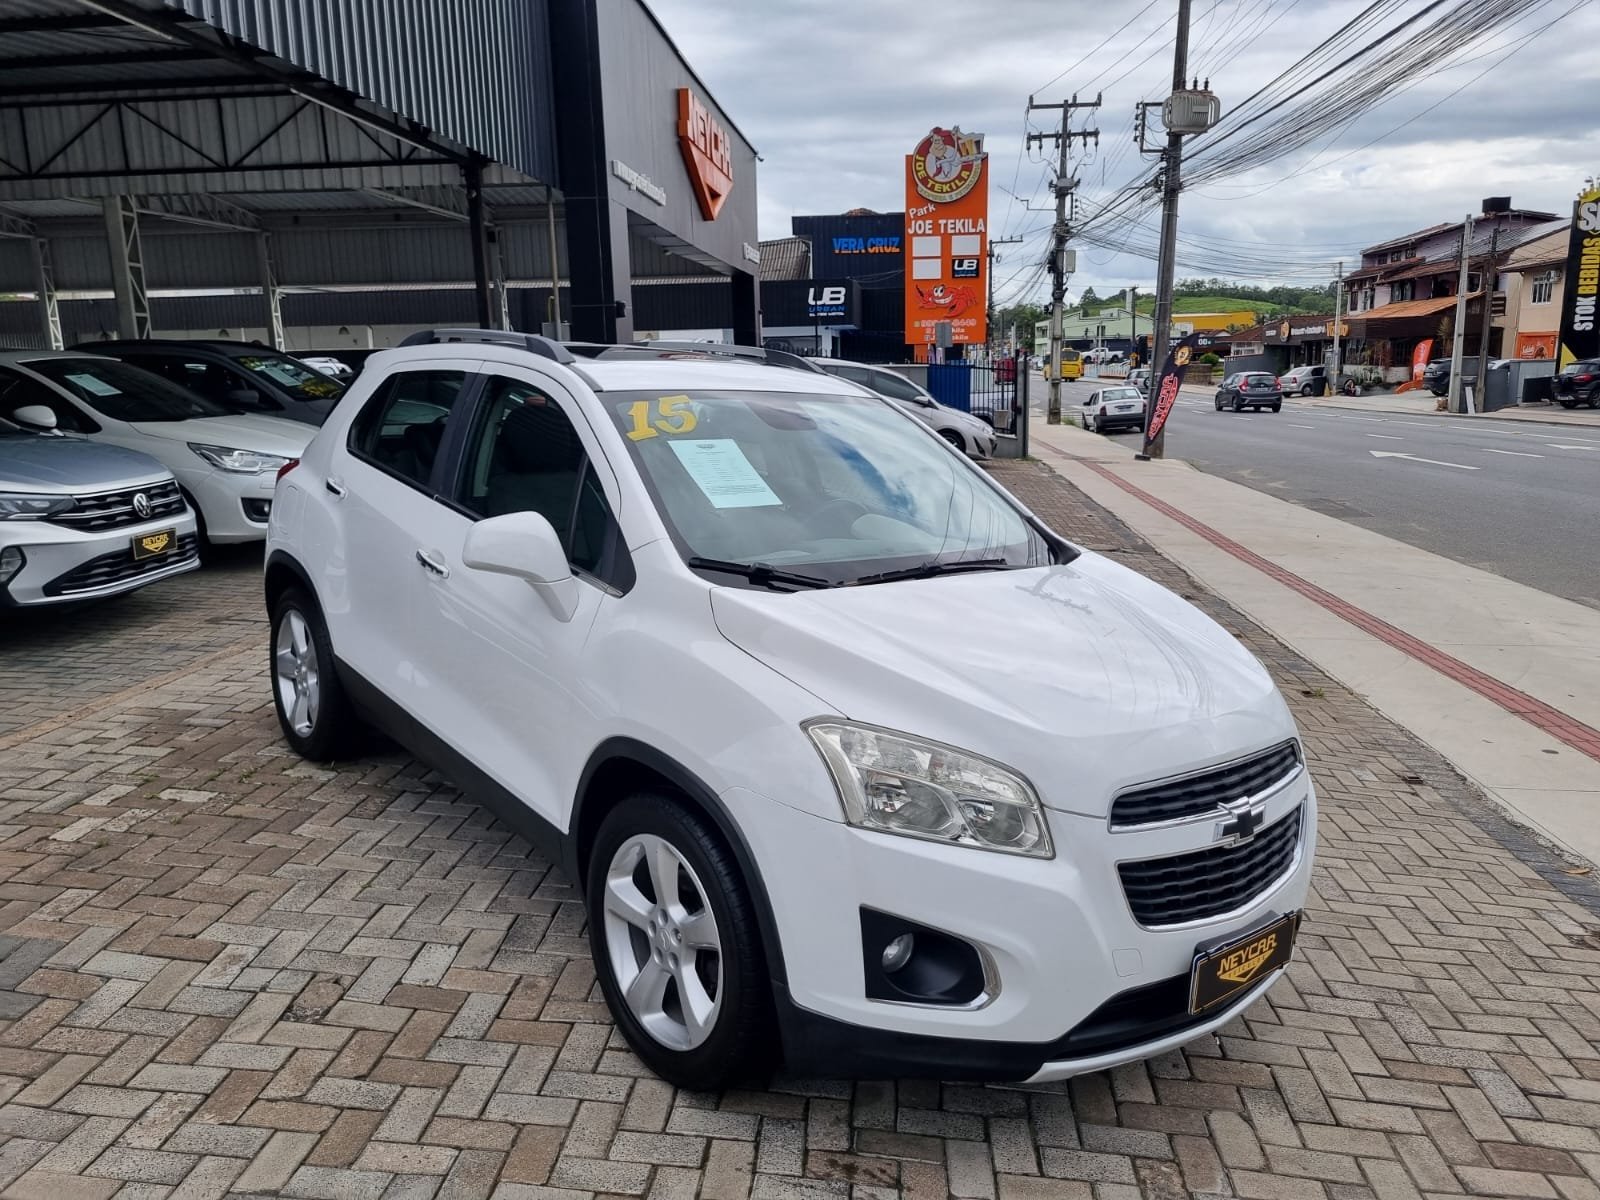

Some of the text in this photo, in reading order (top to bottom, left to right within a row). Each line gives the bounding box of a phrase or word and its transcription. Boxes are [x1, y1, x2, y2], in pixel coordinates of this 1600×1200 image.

[915, 154, 928, 180] JOE
[927, 170, 970, 193] TEKILA
[908, 202, 936, 219] Park
[907, 218, 986, 235] JOE TEKILA
[832, 236, 901, 254] VERA CRUZ
[1573, 237, 1600, 331] STOK BEBIDAS
[808, 286, 846, 305] UB
[808, 305, 846, 313] URBAN
[626, 394, 698, 441] 15
[143, 533, 169, 547] NEYCAR
[1217, 933, 1278, 976] NEYCAR
